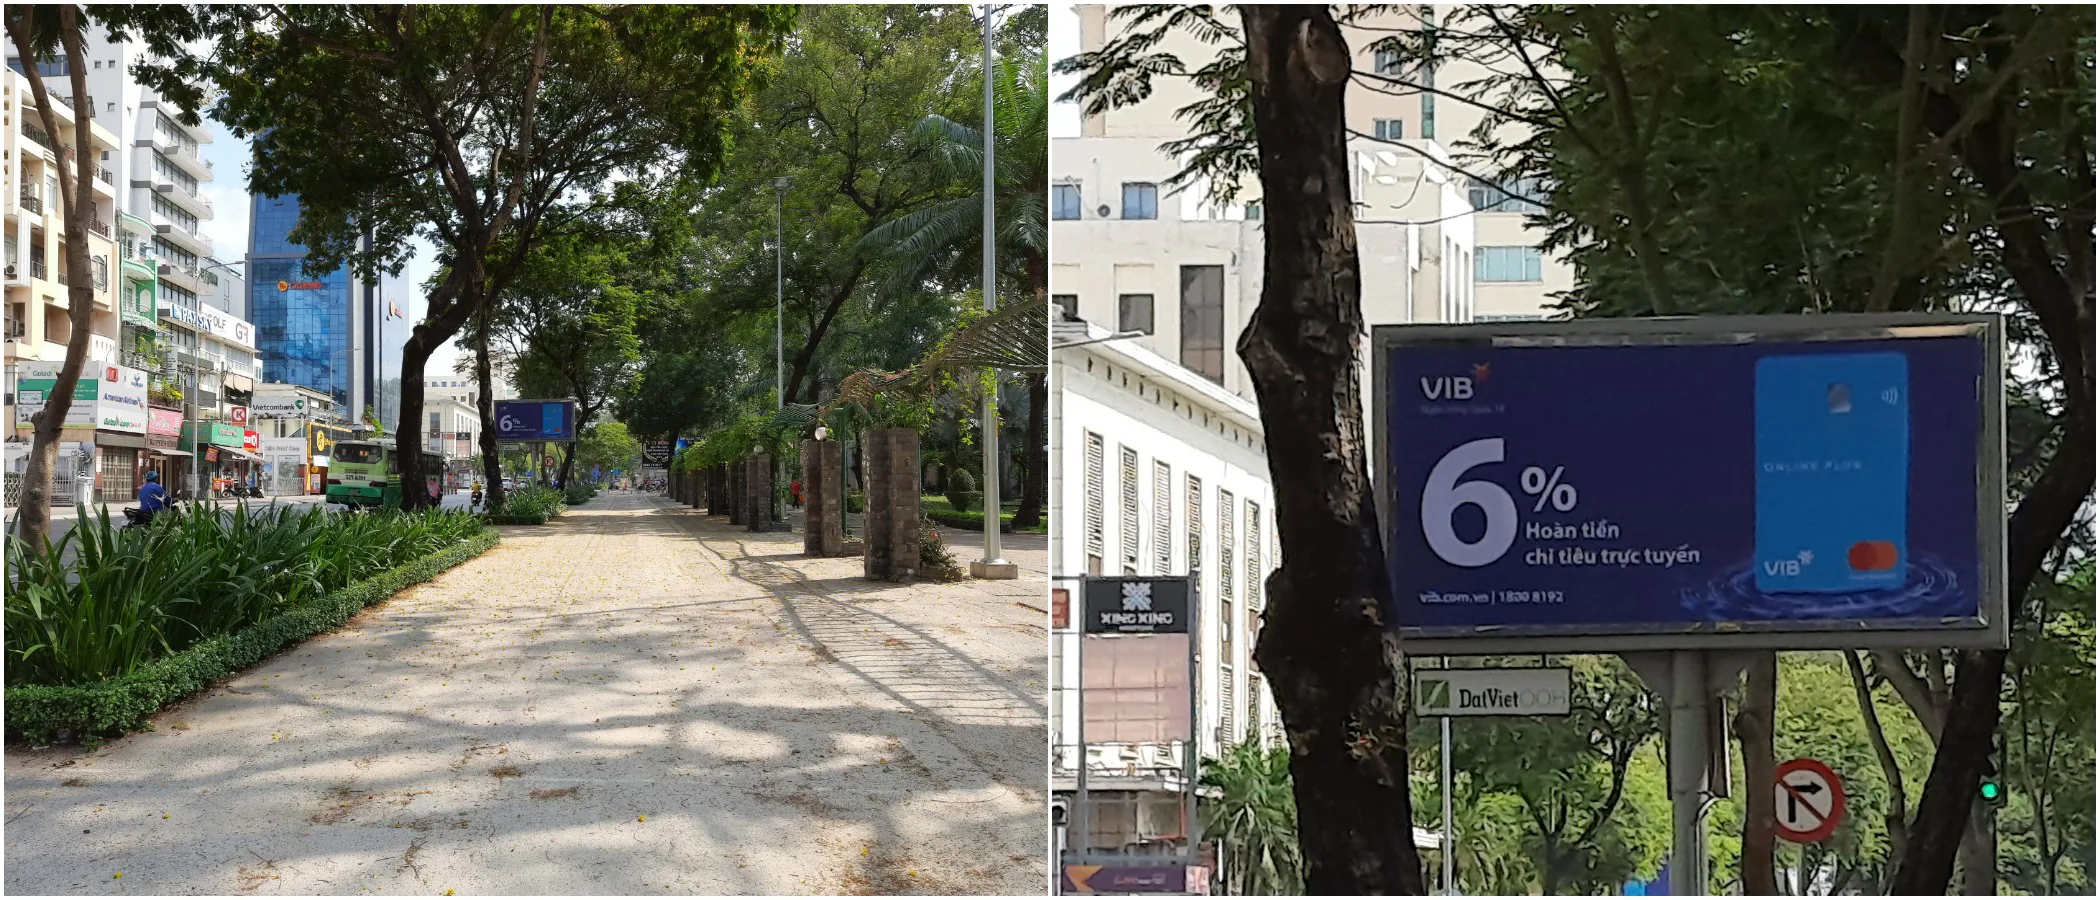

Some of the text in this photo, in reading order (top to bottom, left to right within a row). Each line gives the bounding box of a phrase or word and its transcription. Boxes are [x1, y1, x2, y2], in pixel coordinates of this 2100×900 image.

[1420, 376, 1474, 400] VIB
[252, 403, 295, 411] Vietcombank
[1525, 521, 1577, 540] Hoàn
[1558, 549, 1596, 565] tiêu
[1601, 549, 1640, 568] trực
[1643, 544, 1700, 568] tuyến
[1763, 560, 1800, 577] VIB
[1499, 591, 1530, 603] 1800
[1531, 591, 1564, 603] 8192
